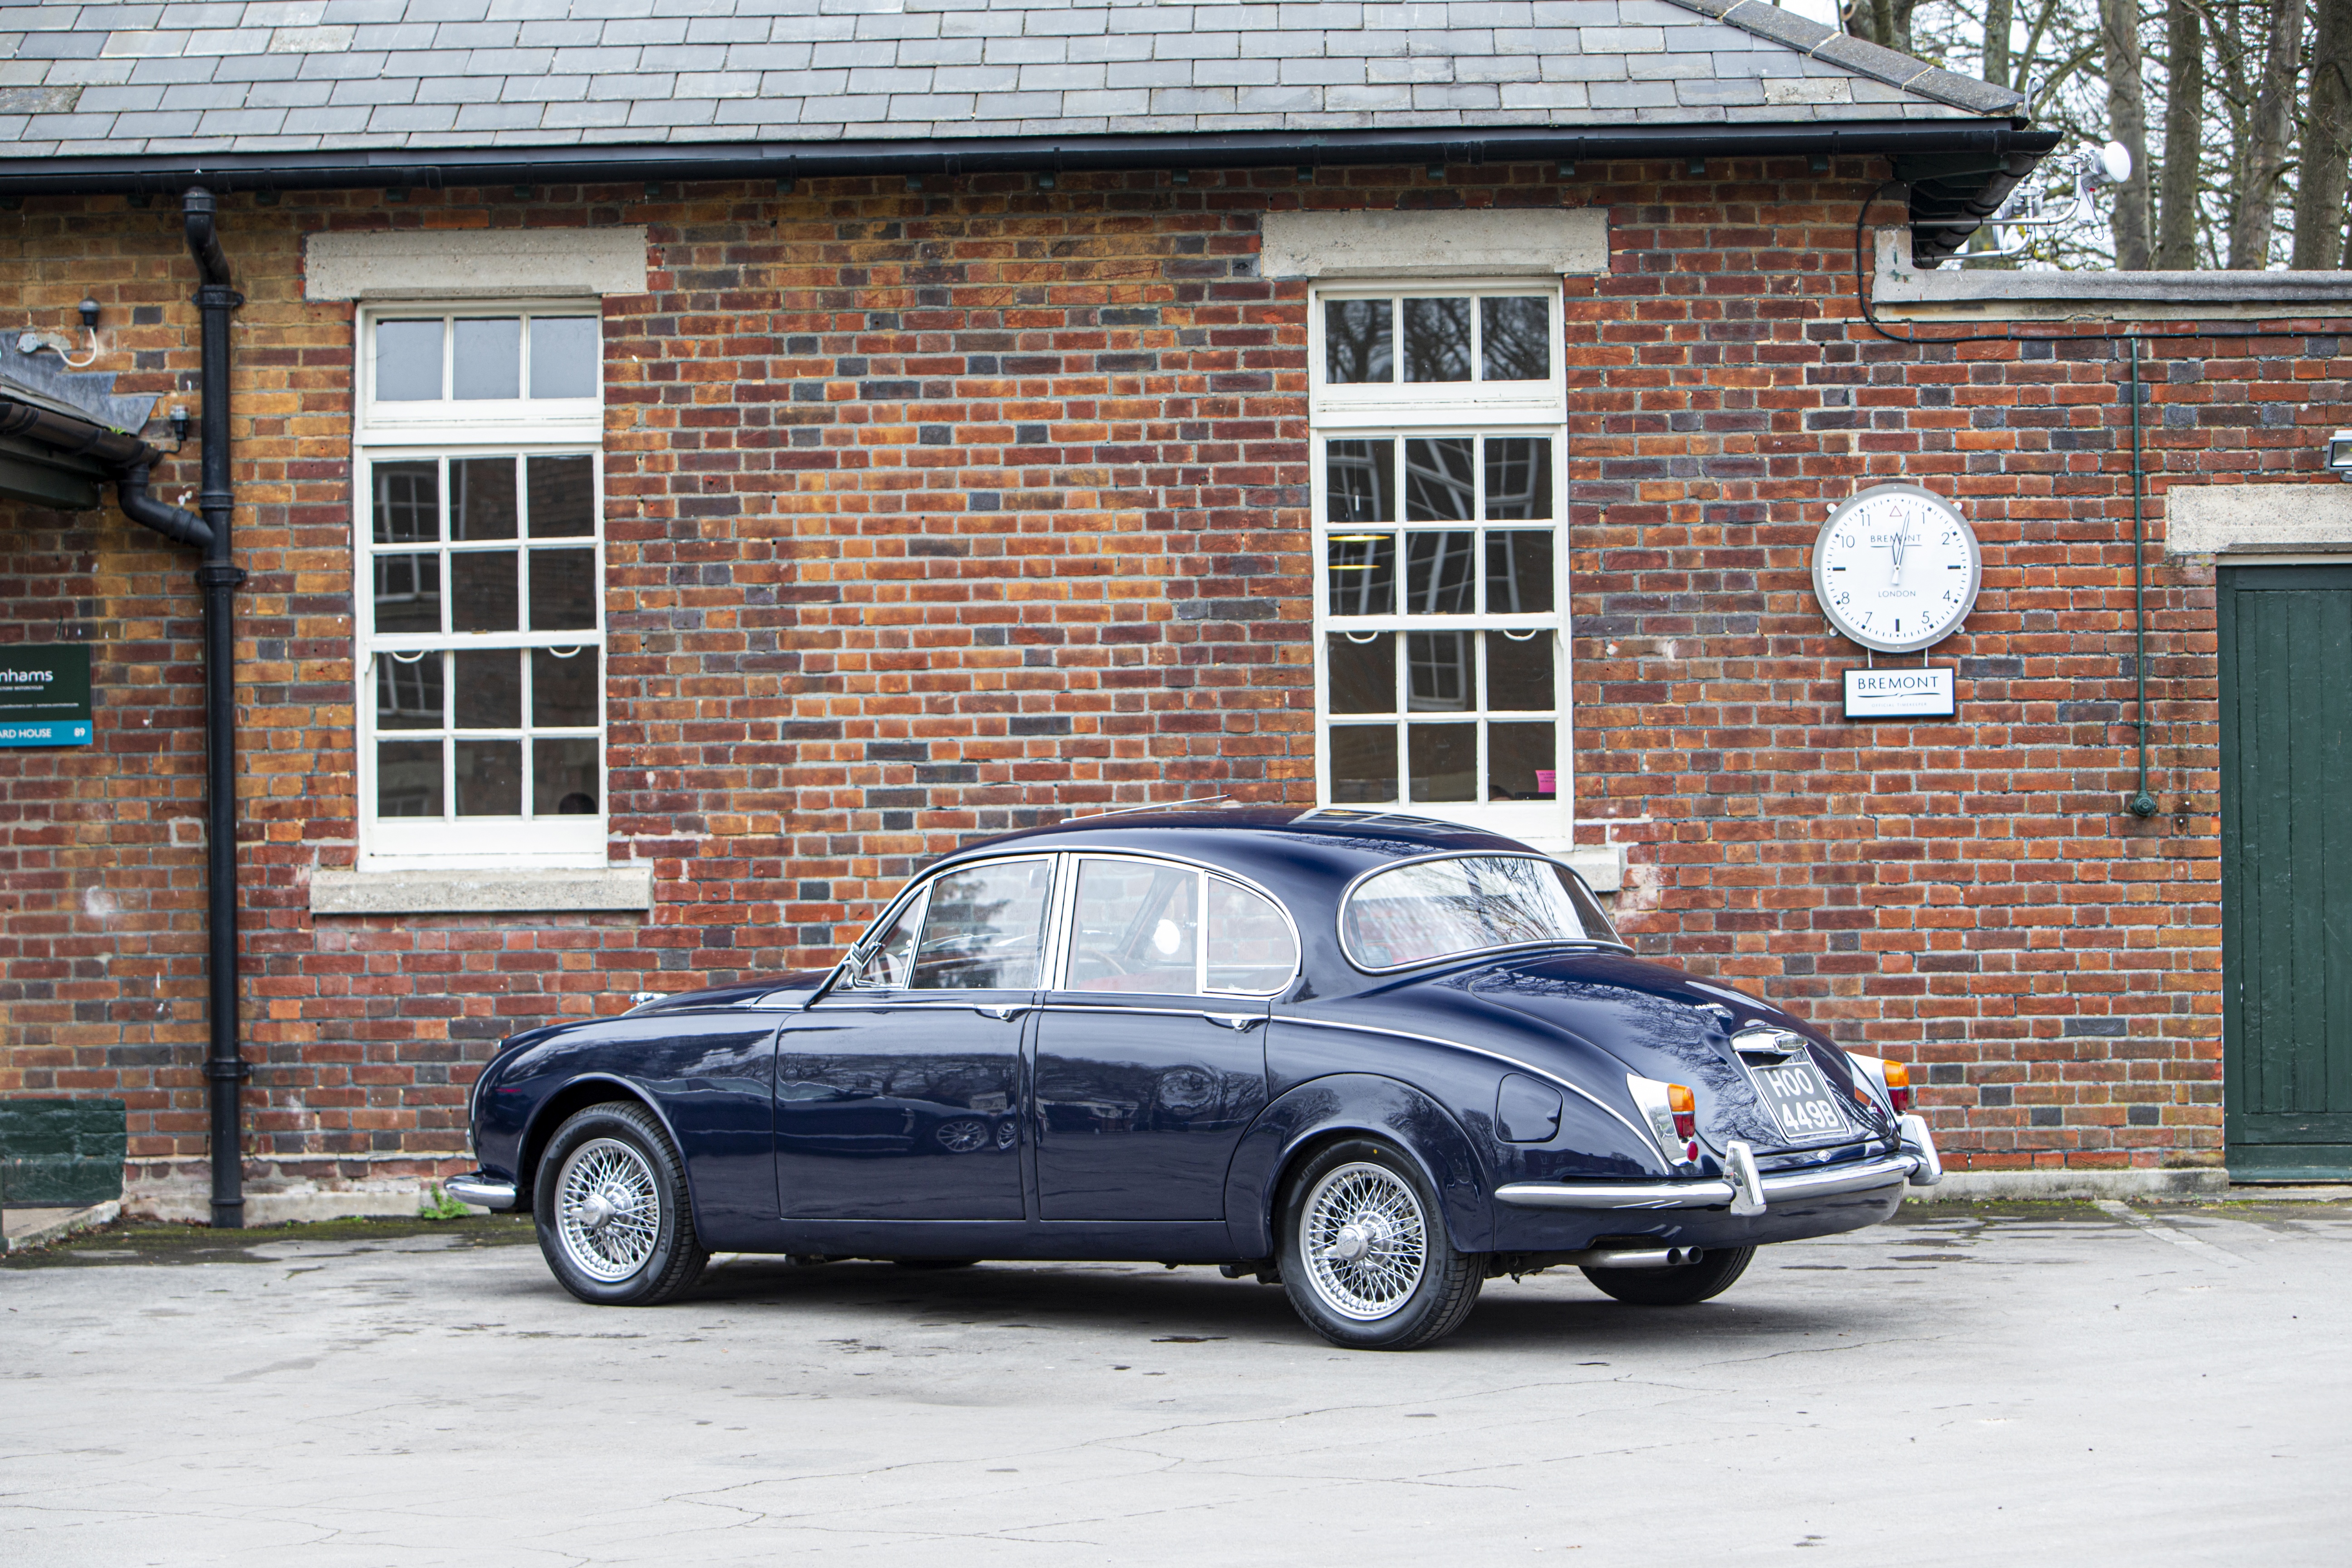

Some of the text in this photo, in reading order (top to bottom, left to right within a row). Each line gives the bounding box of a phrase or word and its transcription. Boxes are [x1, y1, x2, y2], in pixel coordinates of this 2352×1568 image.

[1862, 514, 1870, 526] 11
[1921, 512, 1926, 524] 1
[1841, 535, 1855, 548] 10
[1871, 534, 1921, 543] BREMONT
[1941, 533, 1950, 545] 2
[1842, 592, 1850, 604] 8
[1943, 590, 1951, 602] 4
[1865, 612, 1873, 623] 7
[1922, 611, 1930, 624] 5
[1858, 676, 1939, 690] BREMONT
[19, 728, 52, 739] HOUSE
[74, 727, 85, 737] 89
[1764, 1068, 1814, 1098] HOO
[1782, 1100, 1839, 1131] 449B
